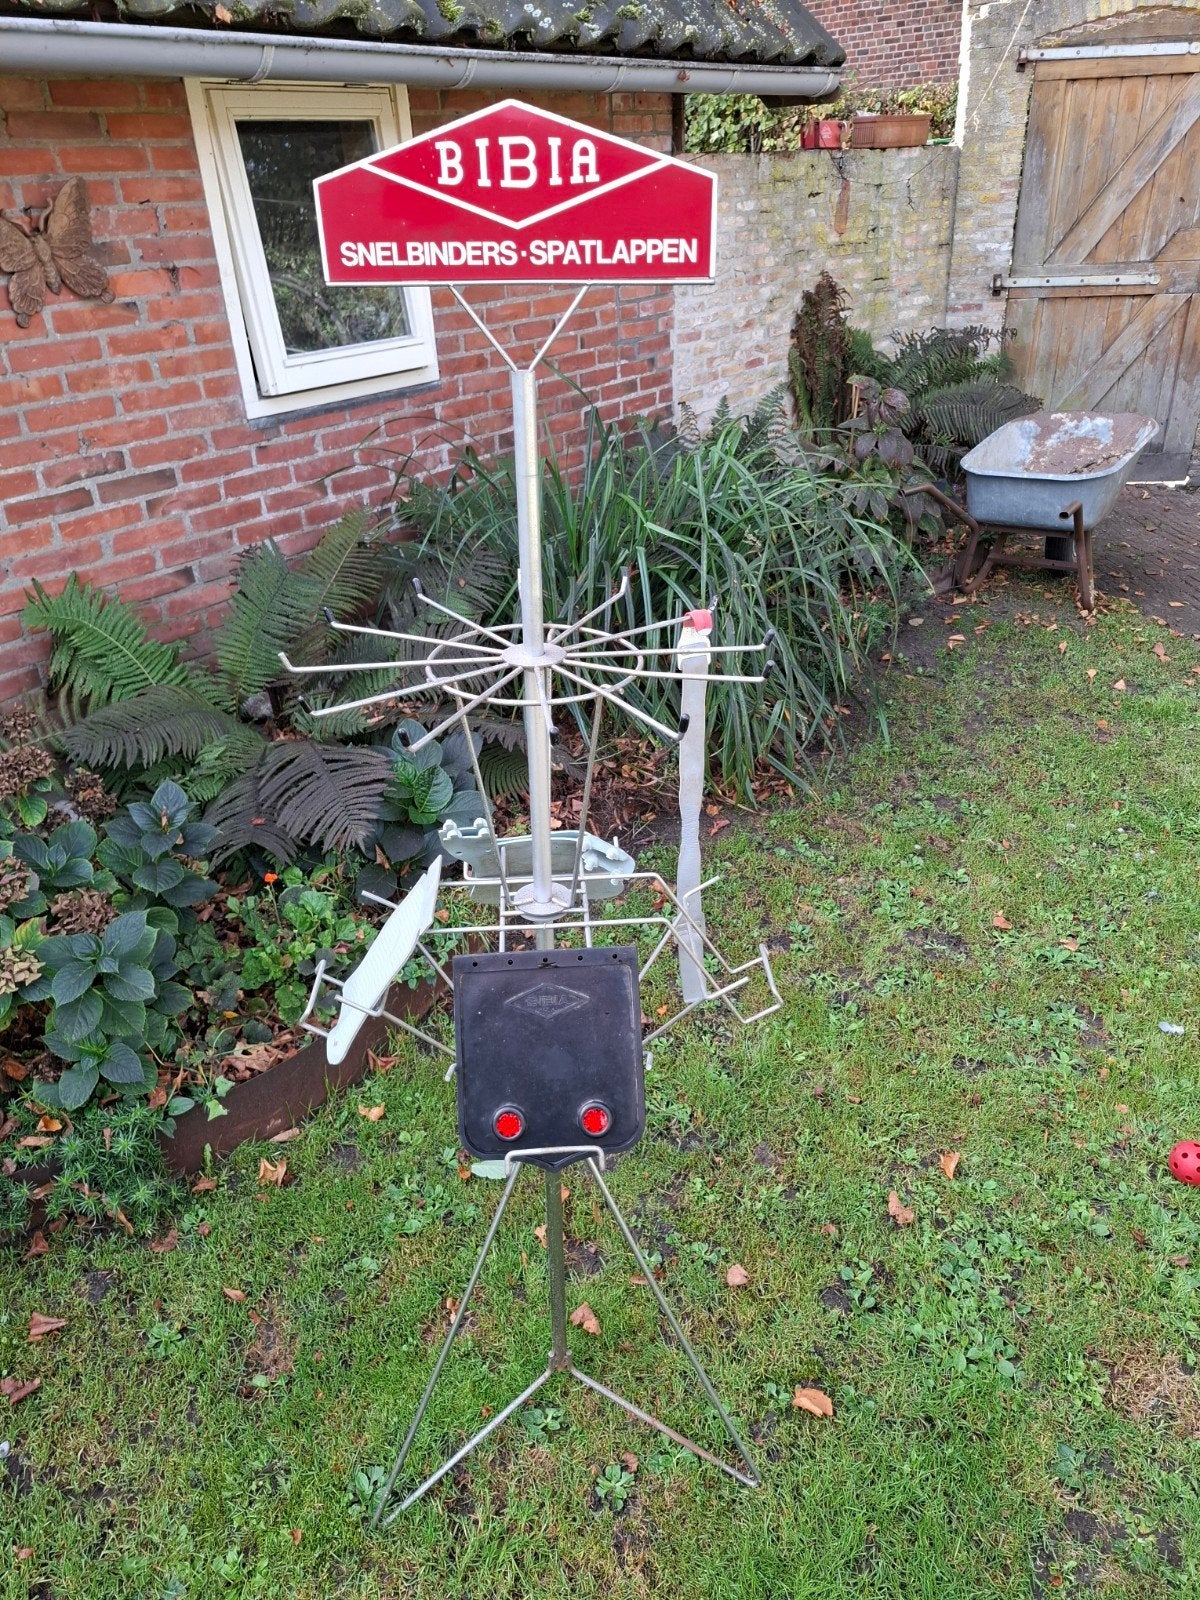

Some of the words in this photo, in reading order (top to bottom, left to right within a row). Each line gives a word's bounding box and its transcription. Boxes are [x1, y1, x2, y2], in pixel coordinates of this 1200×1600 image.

[435, 136, 600, 188] BIBIA
[340, 239, 519, 267] SNELBINDERS
[529, 238, 698, 266] SPATLAPPEN
